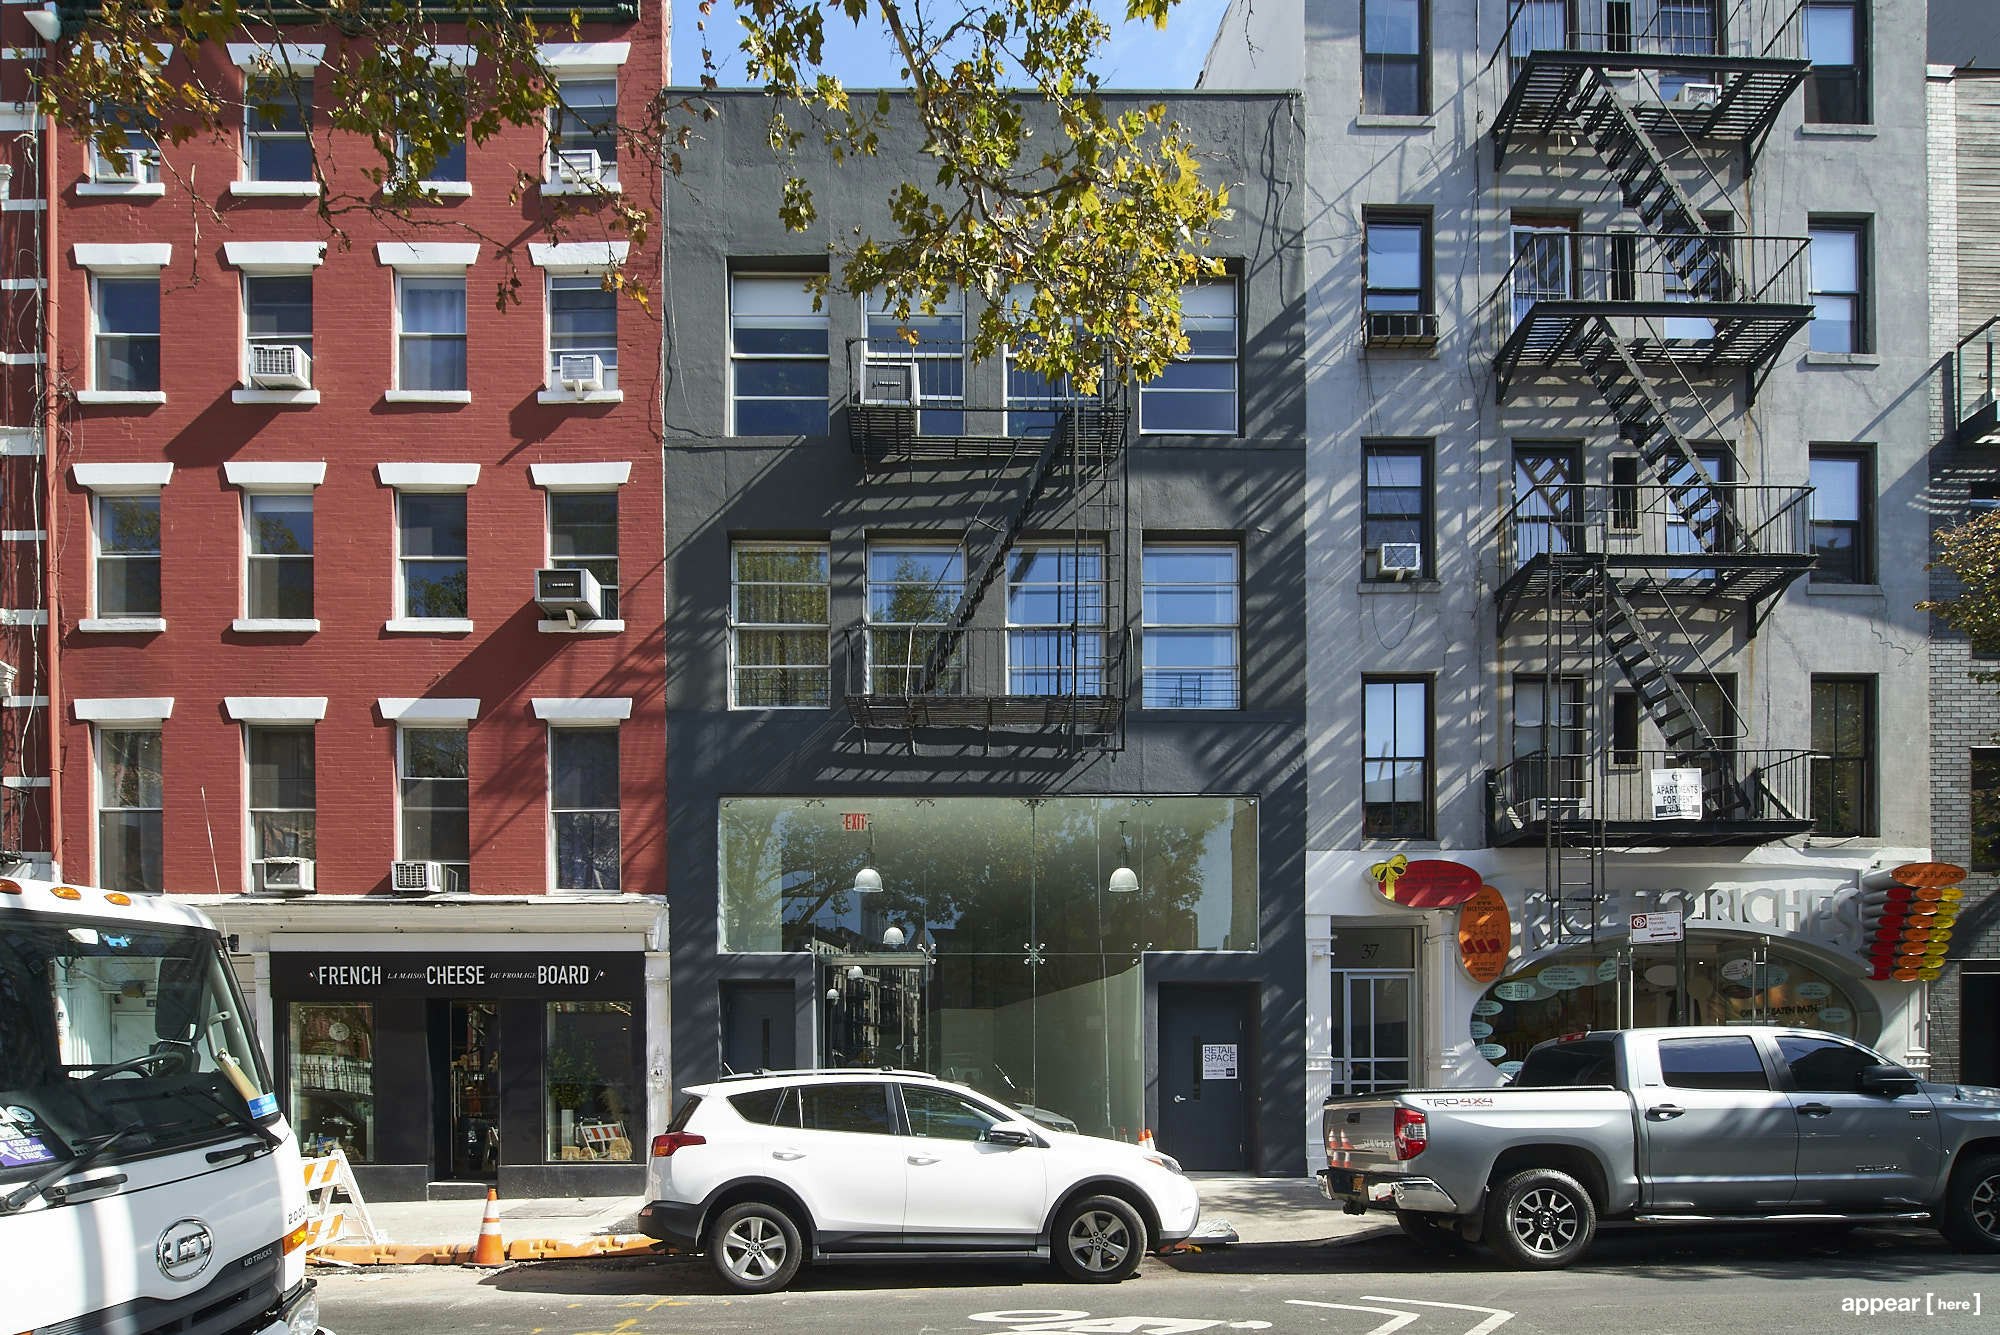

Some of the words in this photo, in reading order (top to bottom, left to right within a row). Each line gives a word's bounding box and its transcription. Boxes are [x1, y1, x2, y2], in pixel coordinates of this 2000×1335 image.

[1663, 795, 1677, 805] FOR
[1678, 795, 1695, 804] RENT
[845, 813, 866, 830] EXIT
[1523, 887, 1621, 951] RICE
[1705, 887, 1864, 951] RICHES
[1360, 943, 1380, 960] 37
[319, 965, 382, 985] FRENCH
[387, 972, 397, 980] LA
[400, 972, 426, 980] MAISON
[426, 965, 486, 985] CHEESE
[537, 965, 589, 985] BOARD
[1204, 1046, 1236, 1054] RETAIL
[1204, 1053, 1236, 1062] SPACE
[1421, 1098, 1459, 1107] TRD
[243, 1255, 253, 1267] UD
[253, 1248, 273, 1264] TRUCKS
